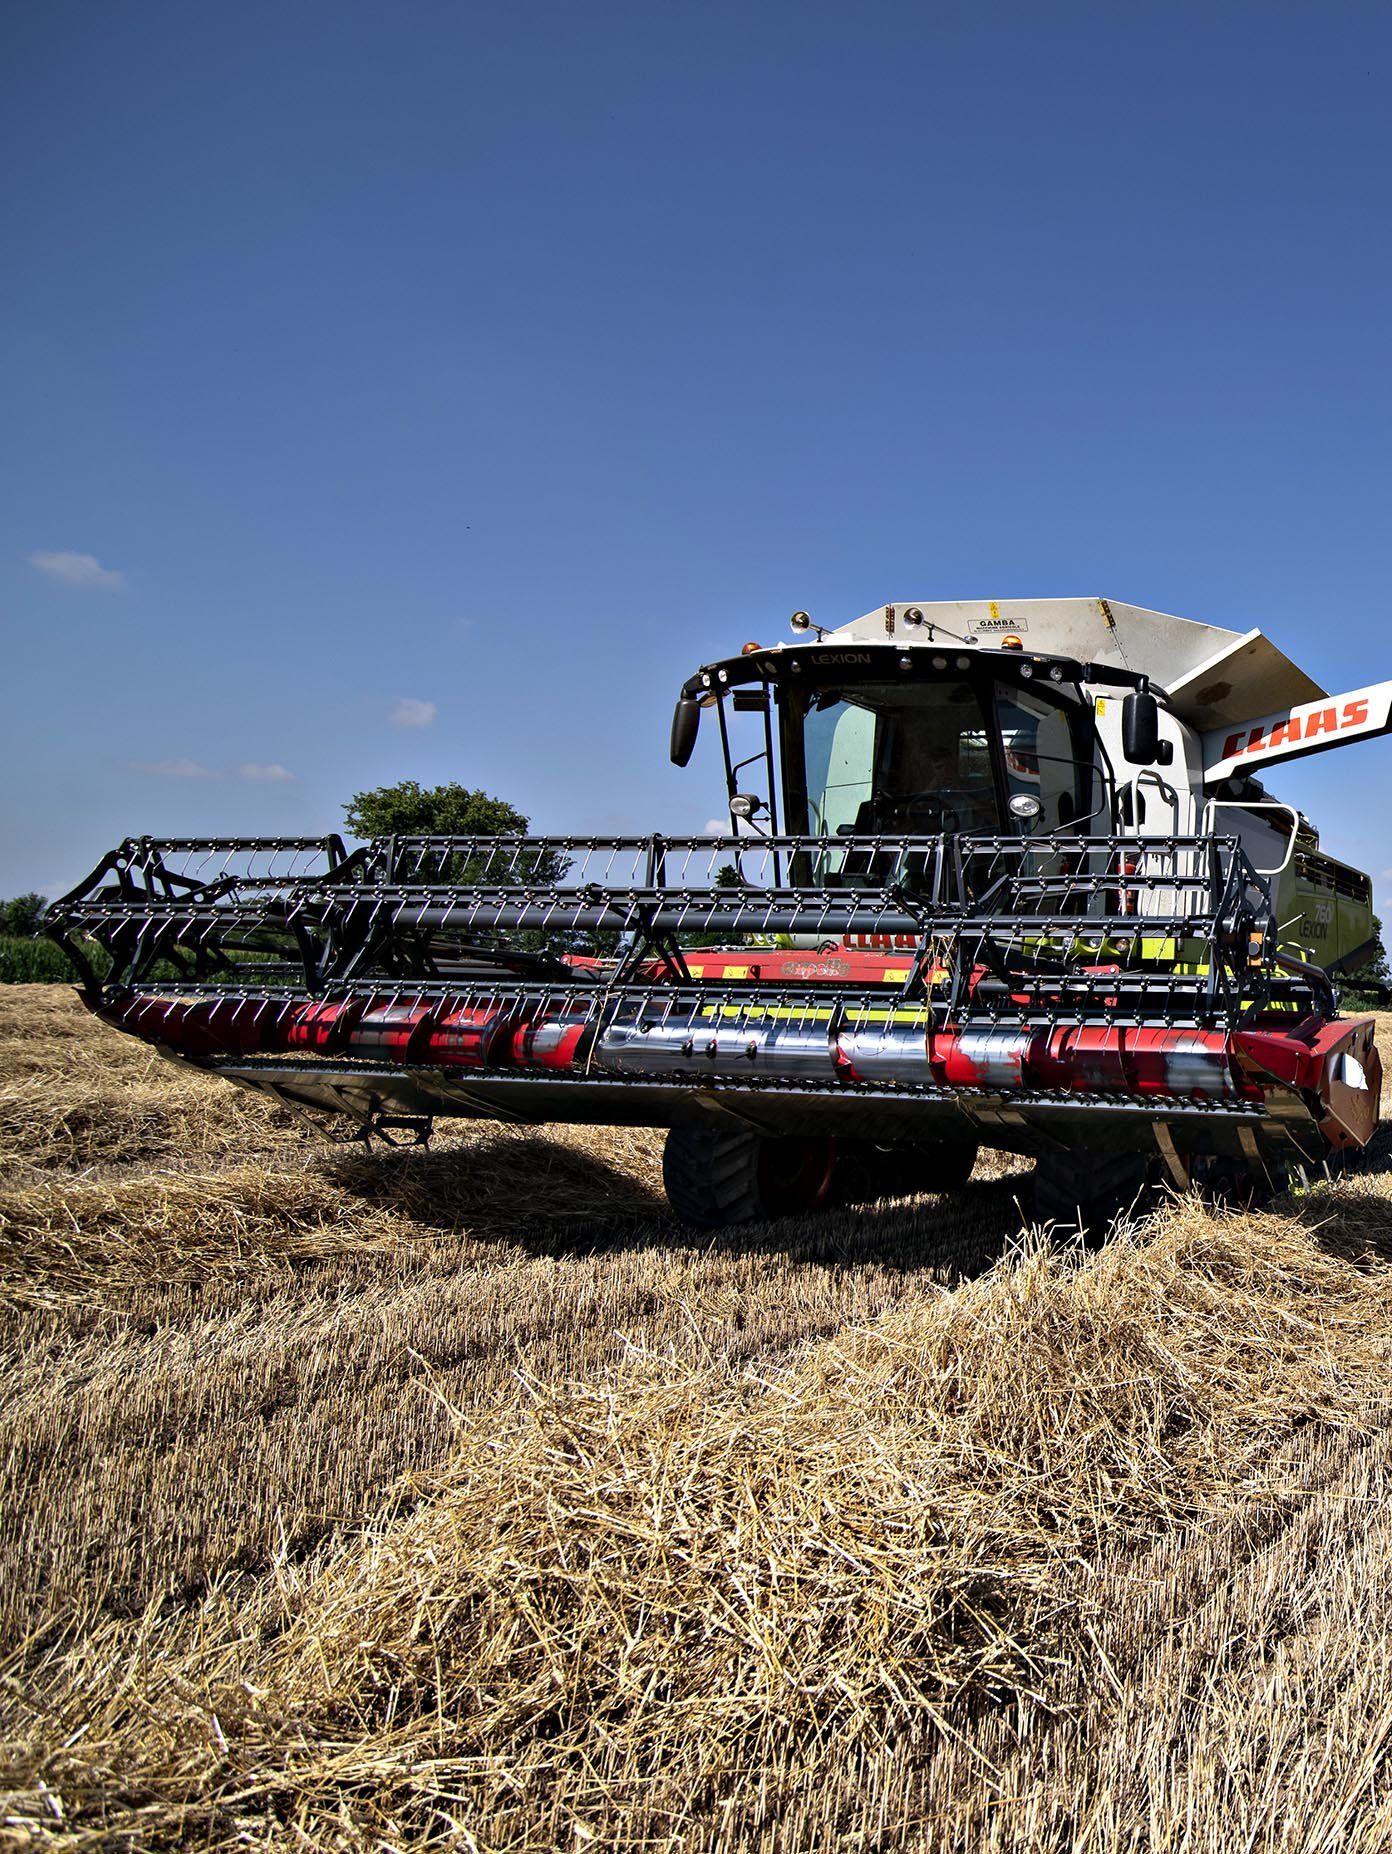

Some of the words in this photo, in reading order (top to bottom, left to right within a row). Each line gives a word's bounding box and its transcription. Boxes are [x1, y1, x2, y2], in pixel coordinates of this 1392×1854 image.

[811, 654, 871, 664] LEXION
[1222, 699, 1369, 760] CLAAS
[1299, 919, 1328, 940] LEXION
